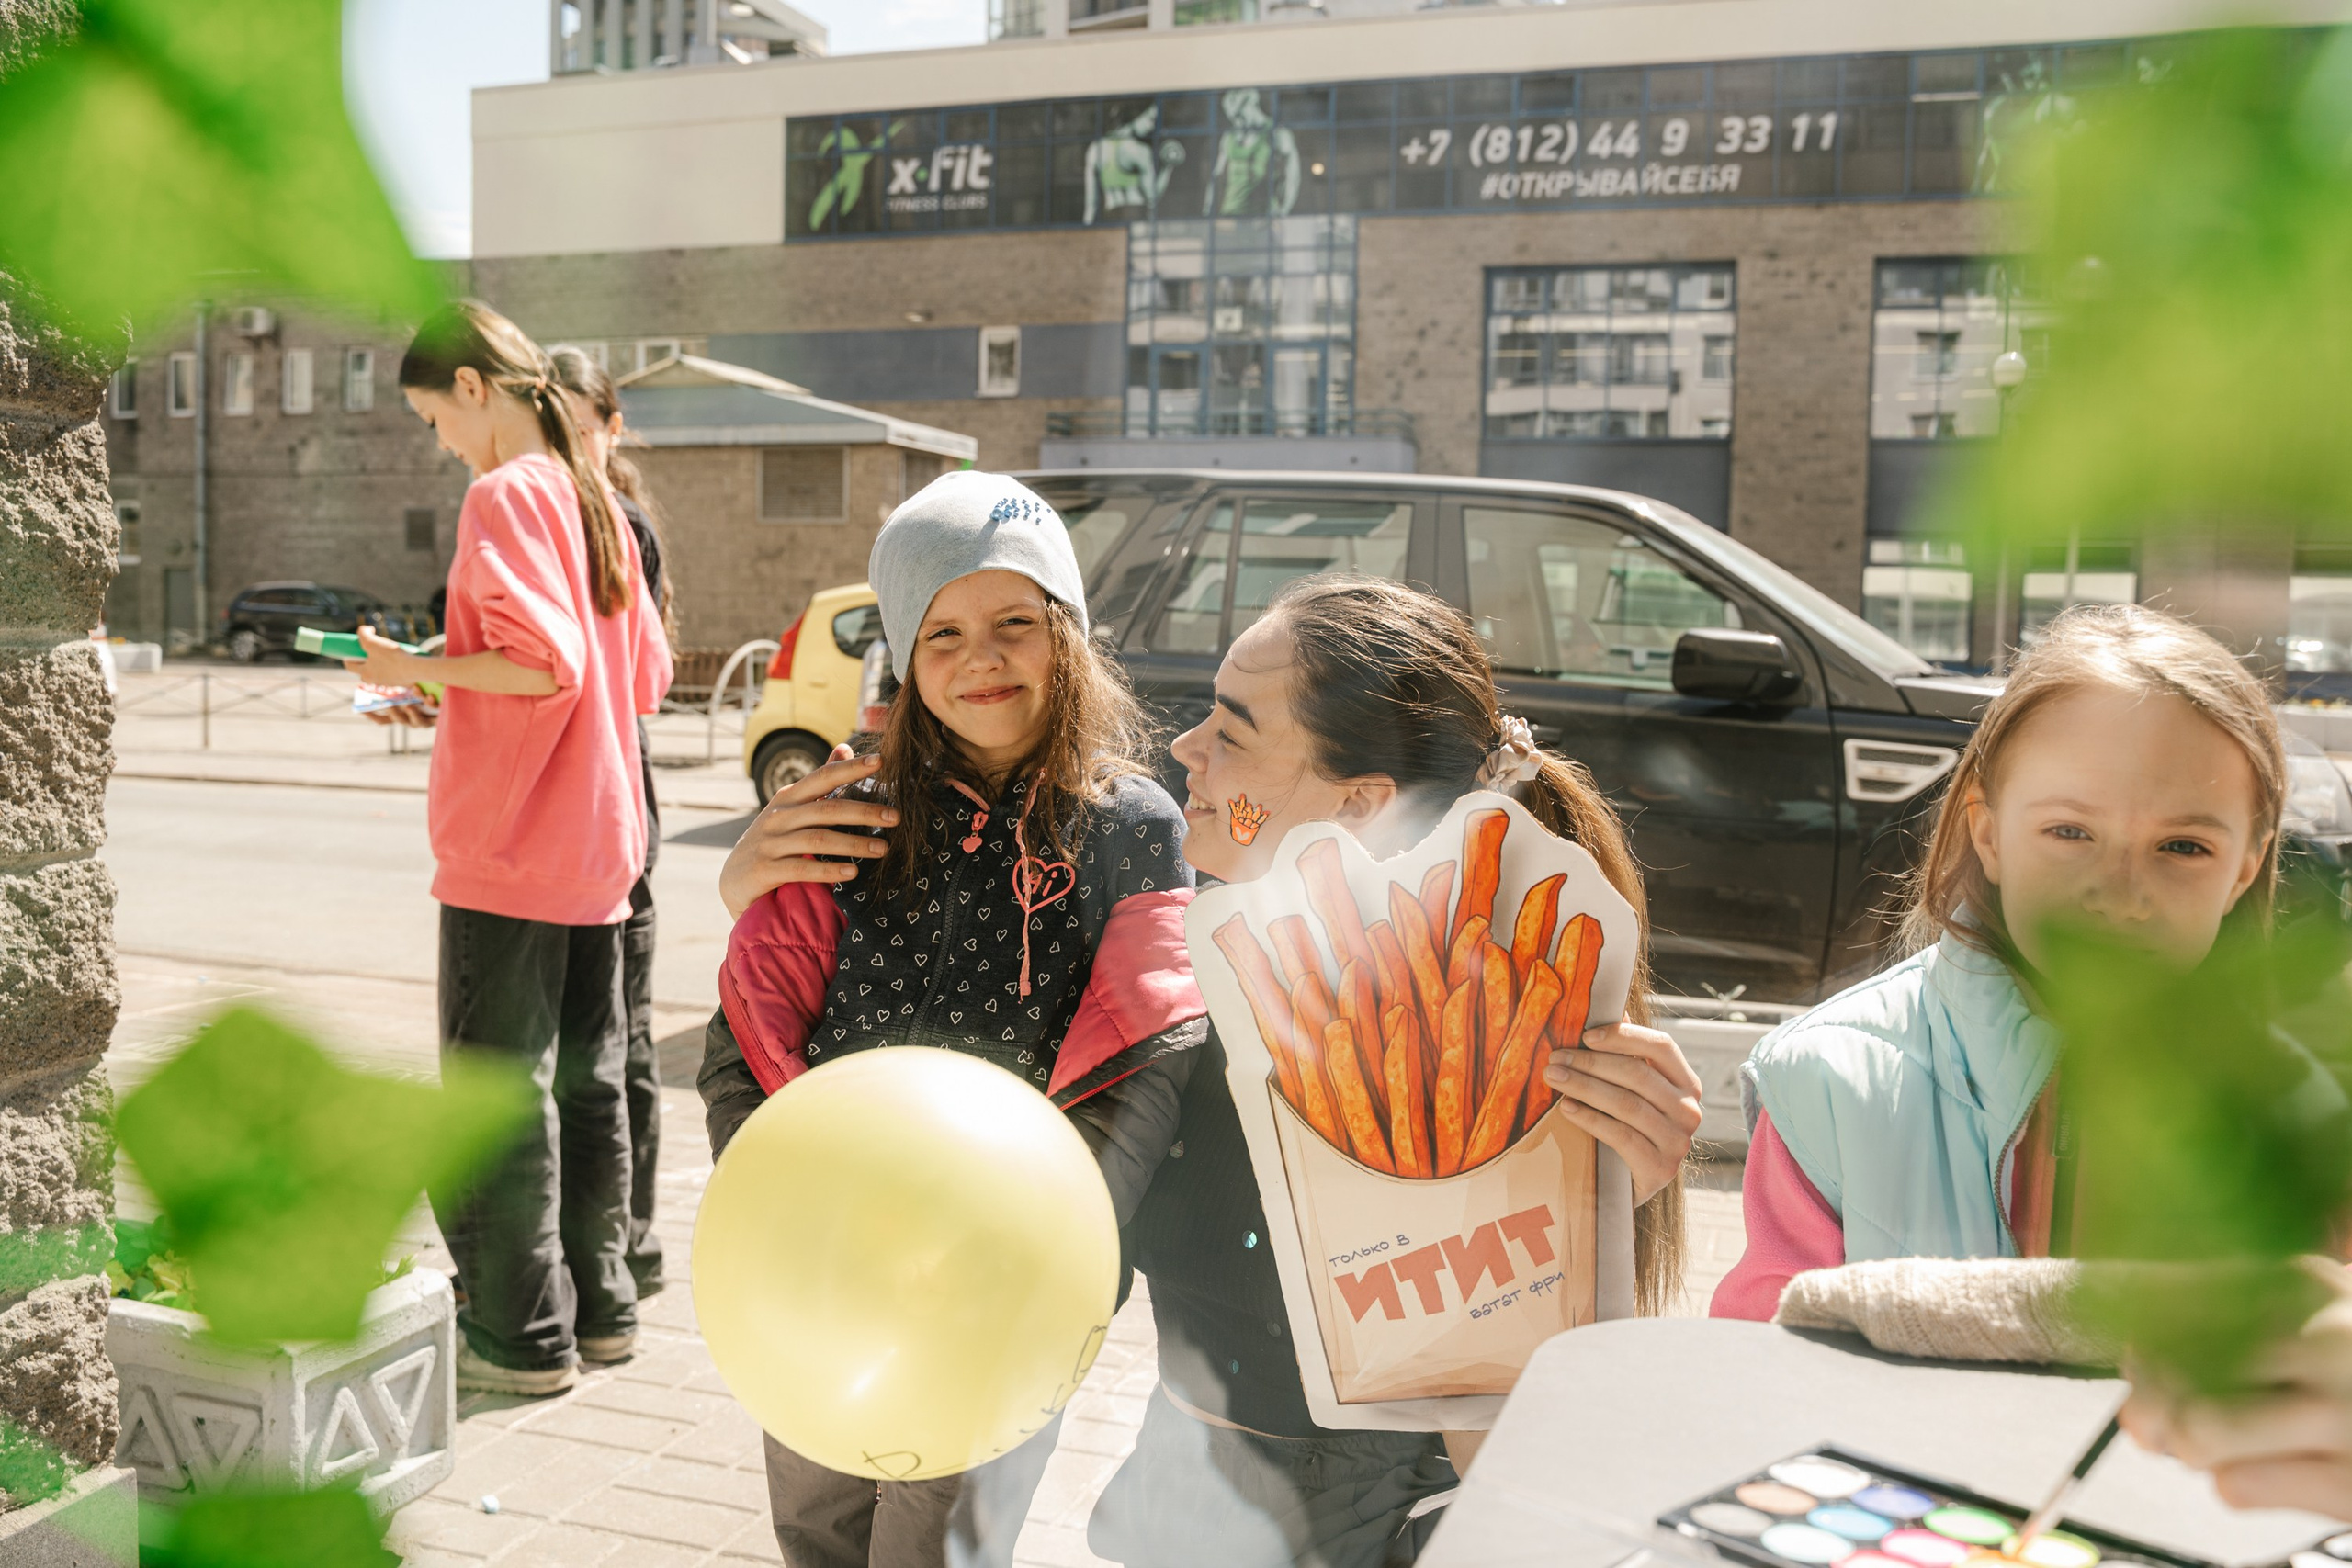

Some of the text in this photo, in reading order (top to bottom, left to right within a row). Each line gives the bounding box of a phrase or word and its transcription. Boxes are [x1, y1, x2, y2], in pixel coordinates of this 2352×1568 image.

[1400, 111, 1838, 167] +7 (812) 44 9 33 11
[1480, 162, 1742, 200] #ОТКРЫВАЙСЕБЯ
[1329, 1241, 1389, 1267] только
[1334, 1204, 1555, 1324] ИТИТ
[1529, 1271, 1565, 1297] фри
